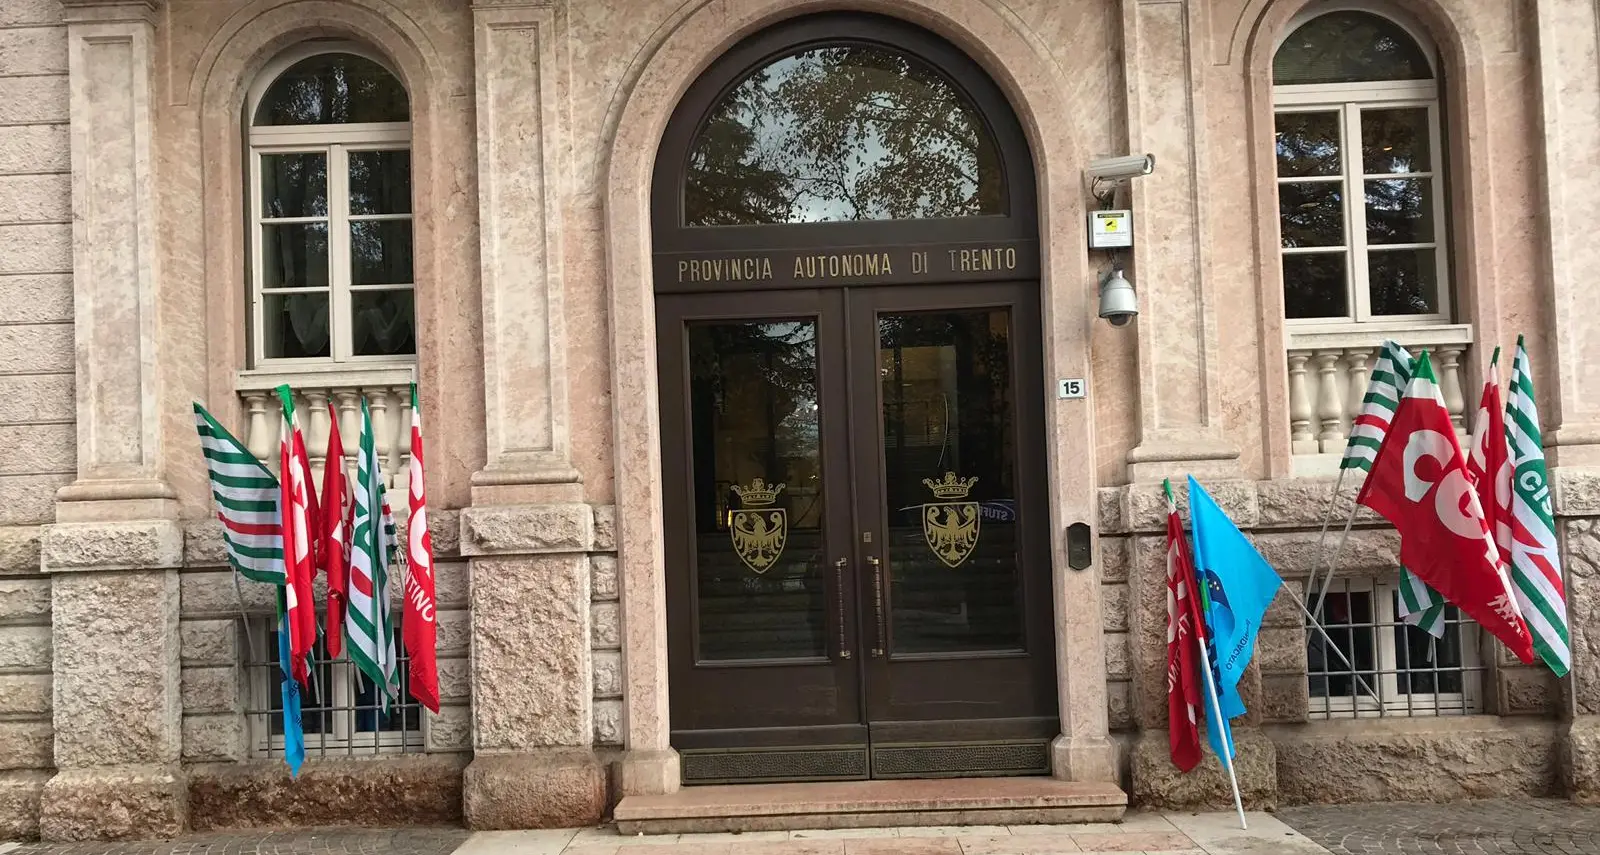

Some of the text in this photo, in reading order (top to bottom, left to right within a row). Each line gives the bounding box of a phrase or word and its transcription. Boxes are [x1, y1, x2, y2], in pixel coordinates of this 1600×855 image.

[678, 247, 1017, 283] PROVINCIA AUTONOMA DI TRENTO
[1063, 381, 1080, 395] 15
